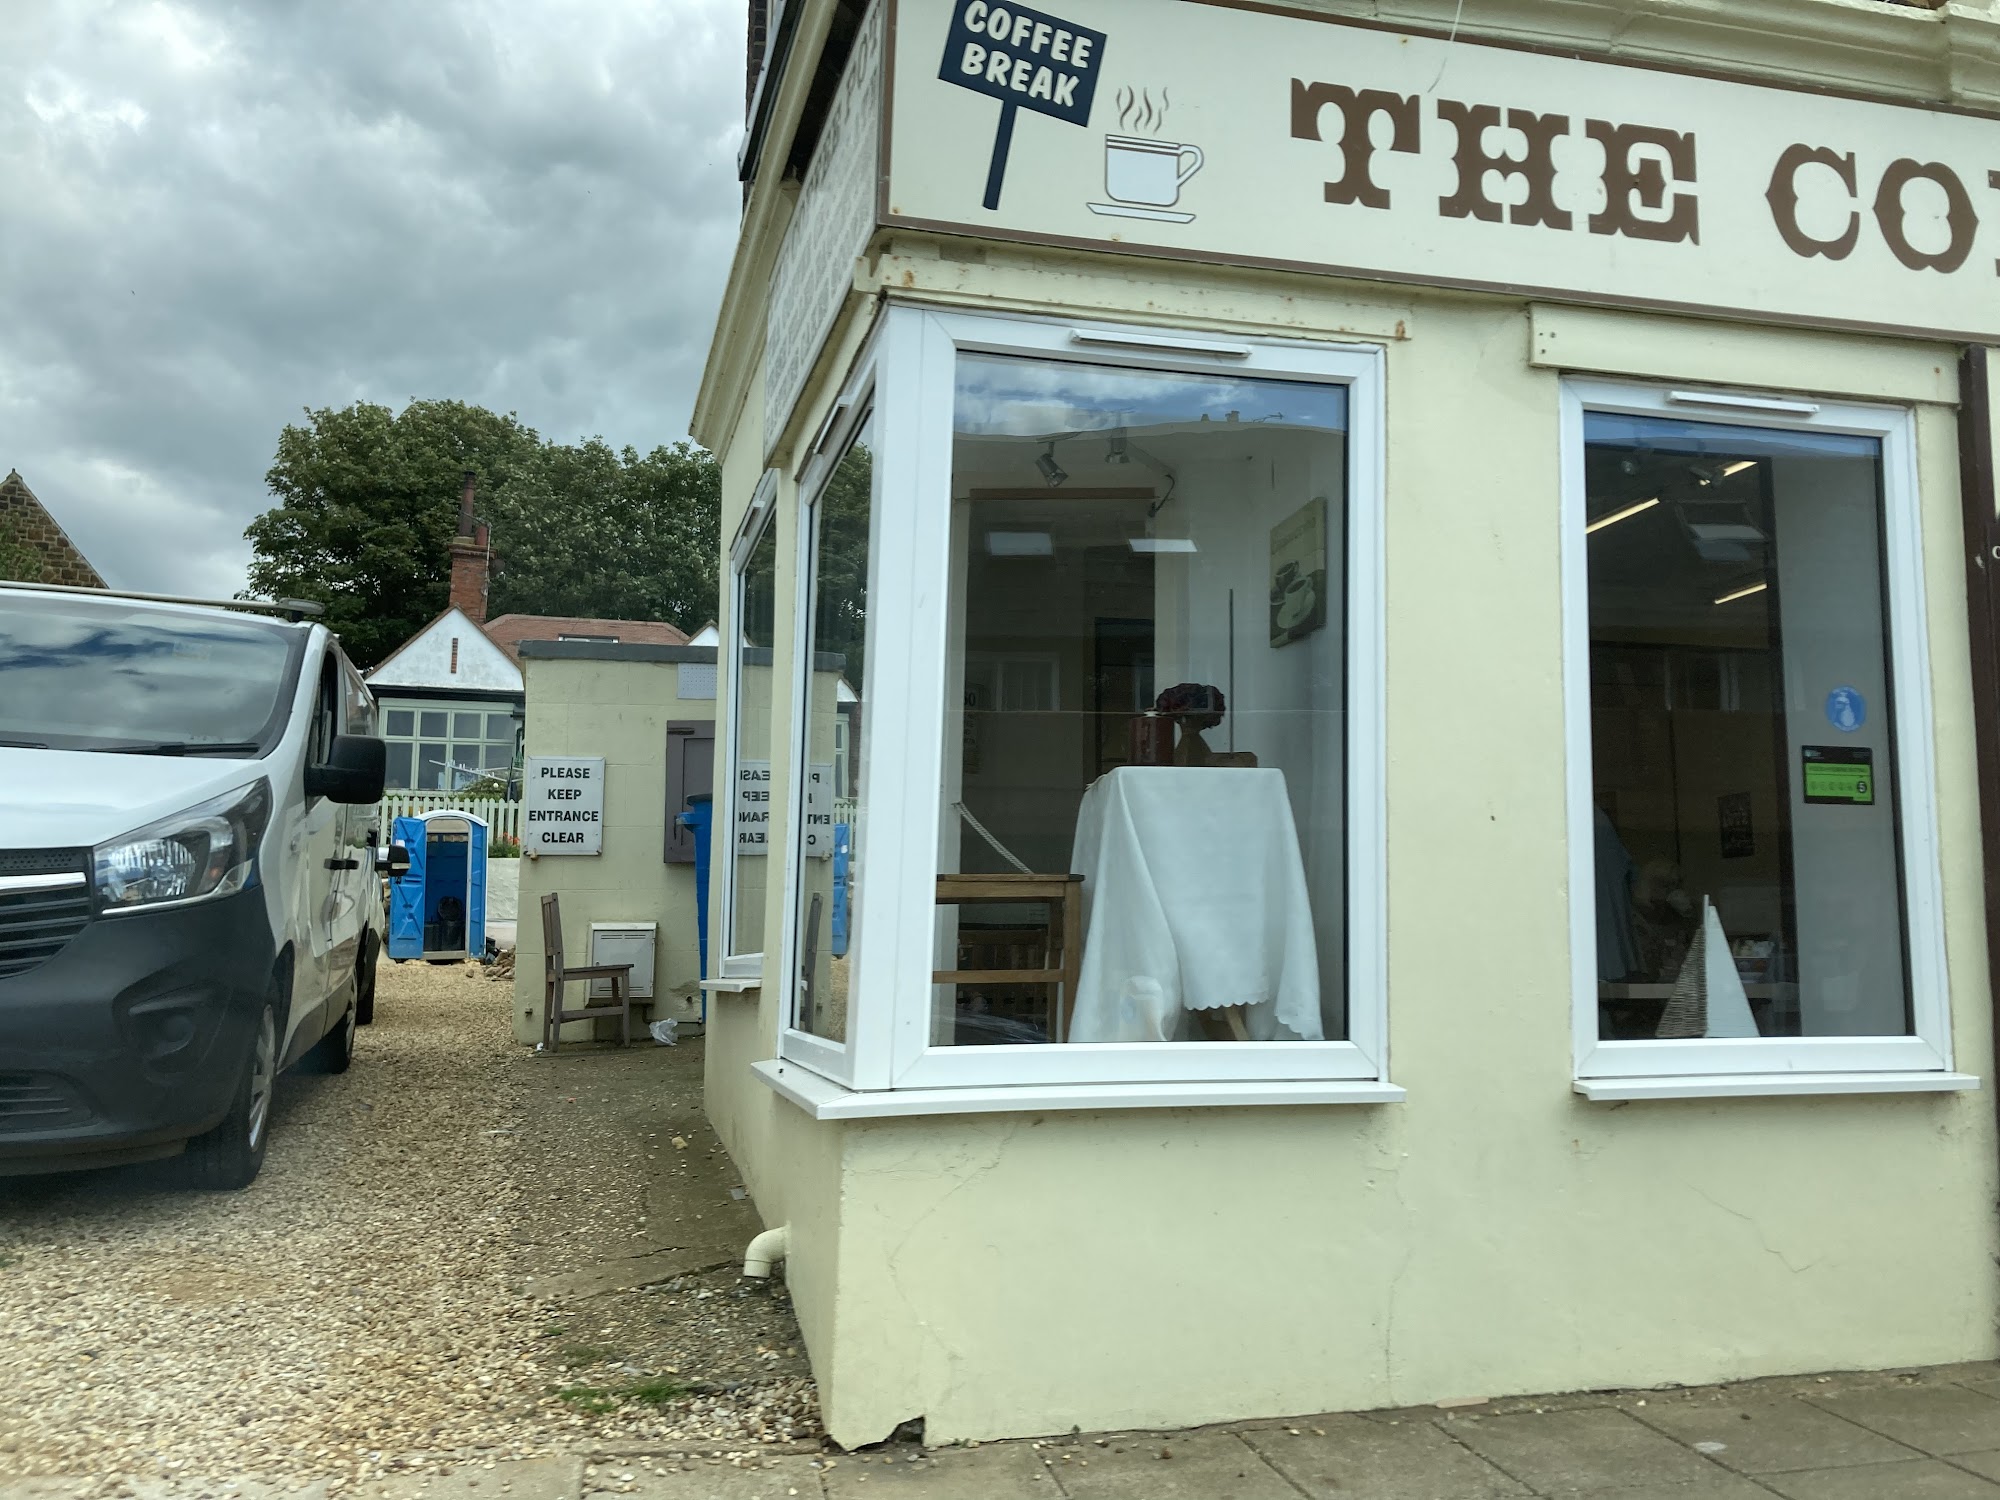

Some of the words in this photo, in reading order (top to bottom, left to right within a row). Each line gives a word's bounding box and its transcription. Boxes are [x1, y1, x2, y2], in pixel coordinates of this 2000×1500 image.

[964, 0, 1093, 68] COFFEE
[960, 42, 1080, 107] BREAK
[1290, 78, 1700, 245] THE
[1765, 142, 2000, 276] CO
[541, 767, 590, 779] PLEASE
[548, 789, 582, 800] KEEP
[529, 810, 599, 822] ENTRANCE
[542, 832, 584, 844] CLEAR
